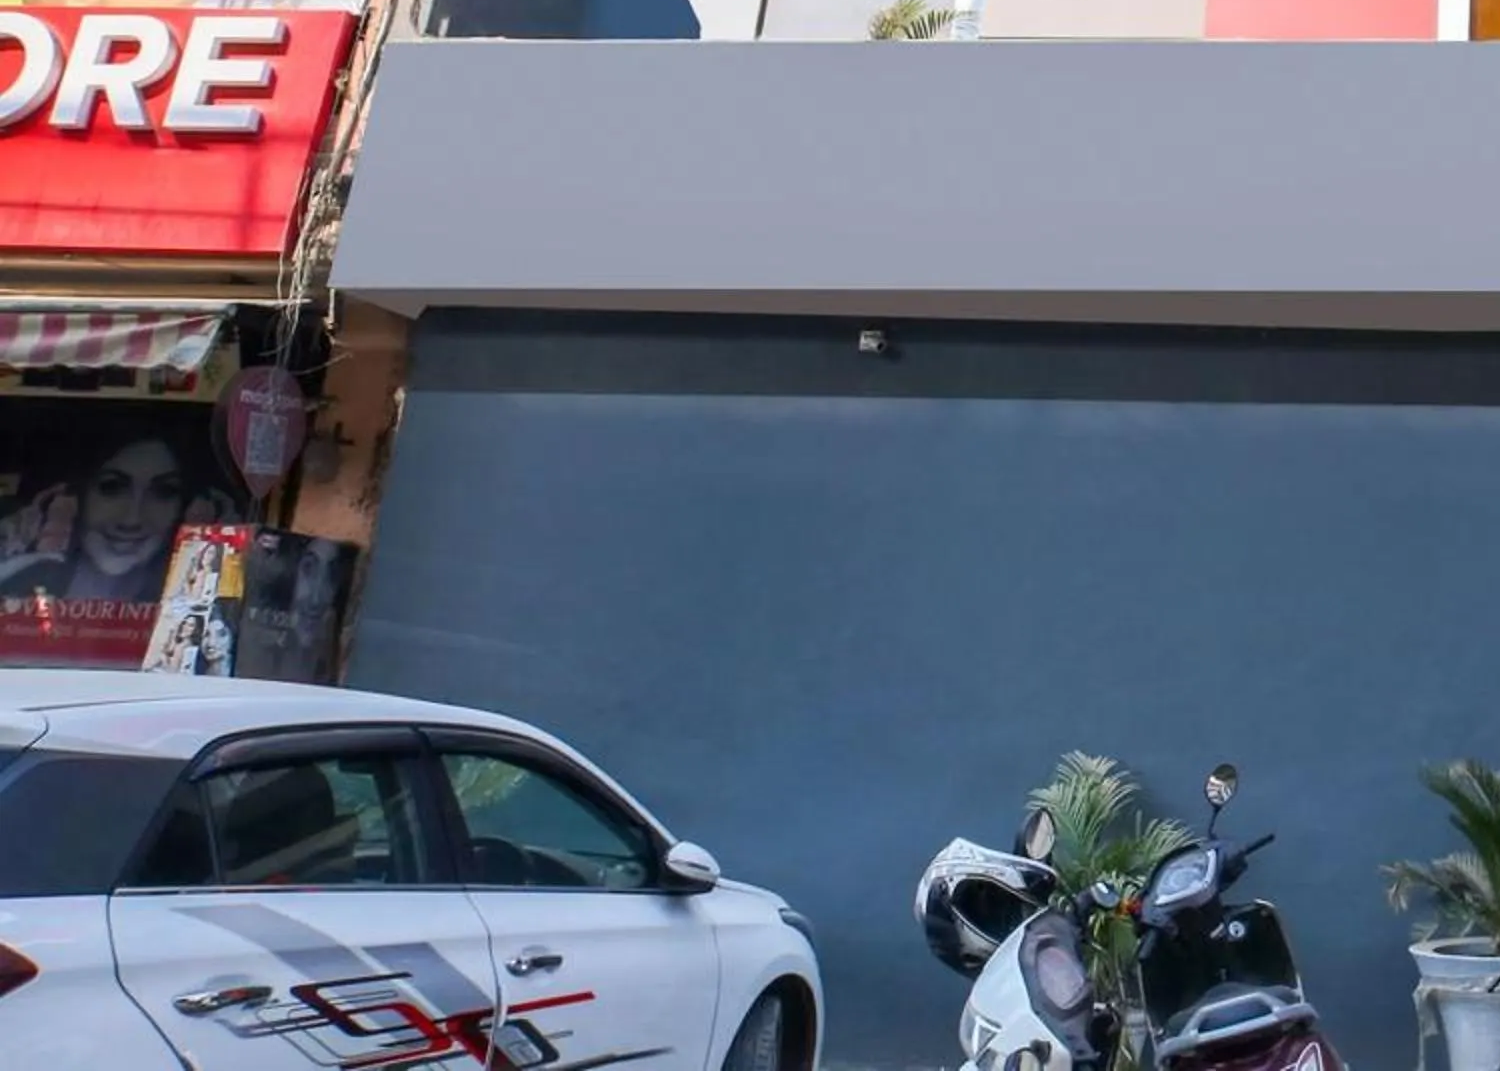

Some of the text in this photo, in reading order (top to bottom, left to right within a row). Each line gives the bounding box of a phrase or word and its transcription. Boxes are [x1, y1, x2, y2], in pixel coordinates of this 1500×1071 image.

[0, 11, 286, 132] ORE
[58, 598, 114, 619] YOUR
[118, 602, 161, 621] INT
